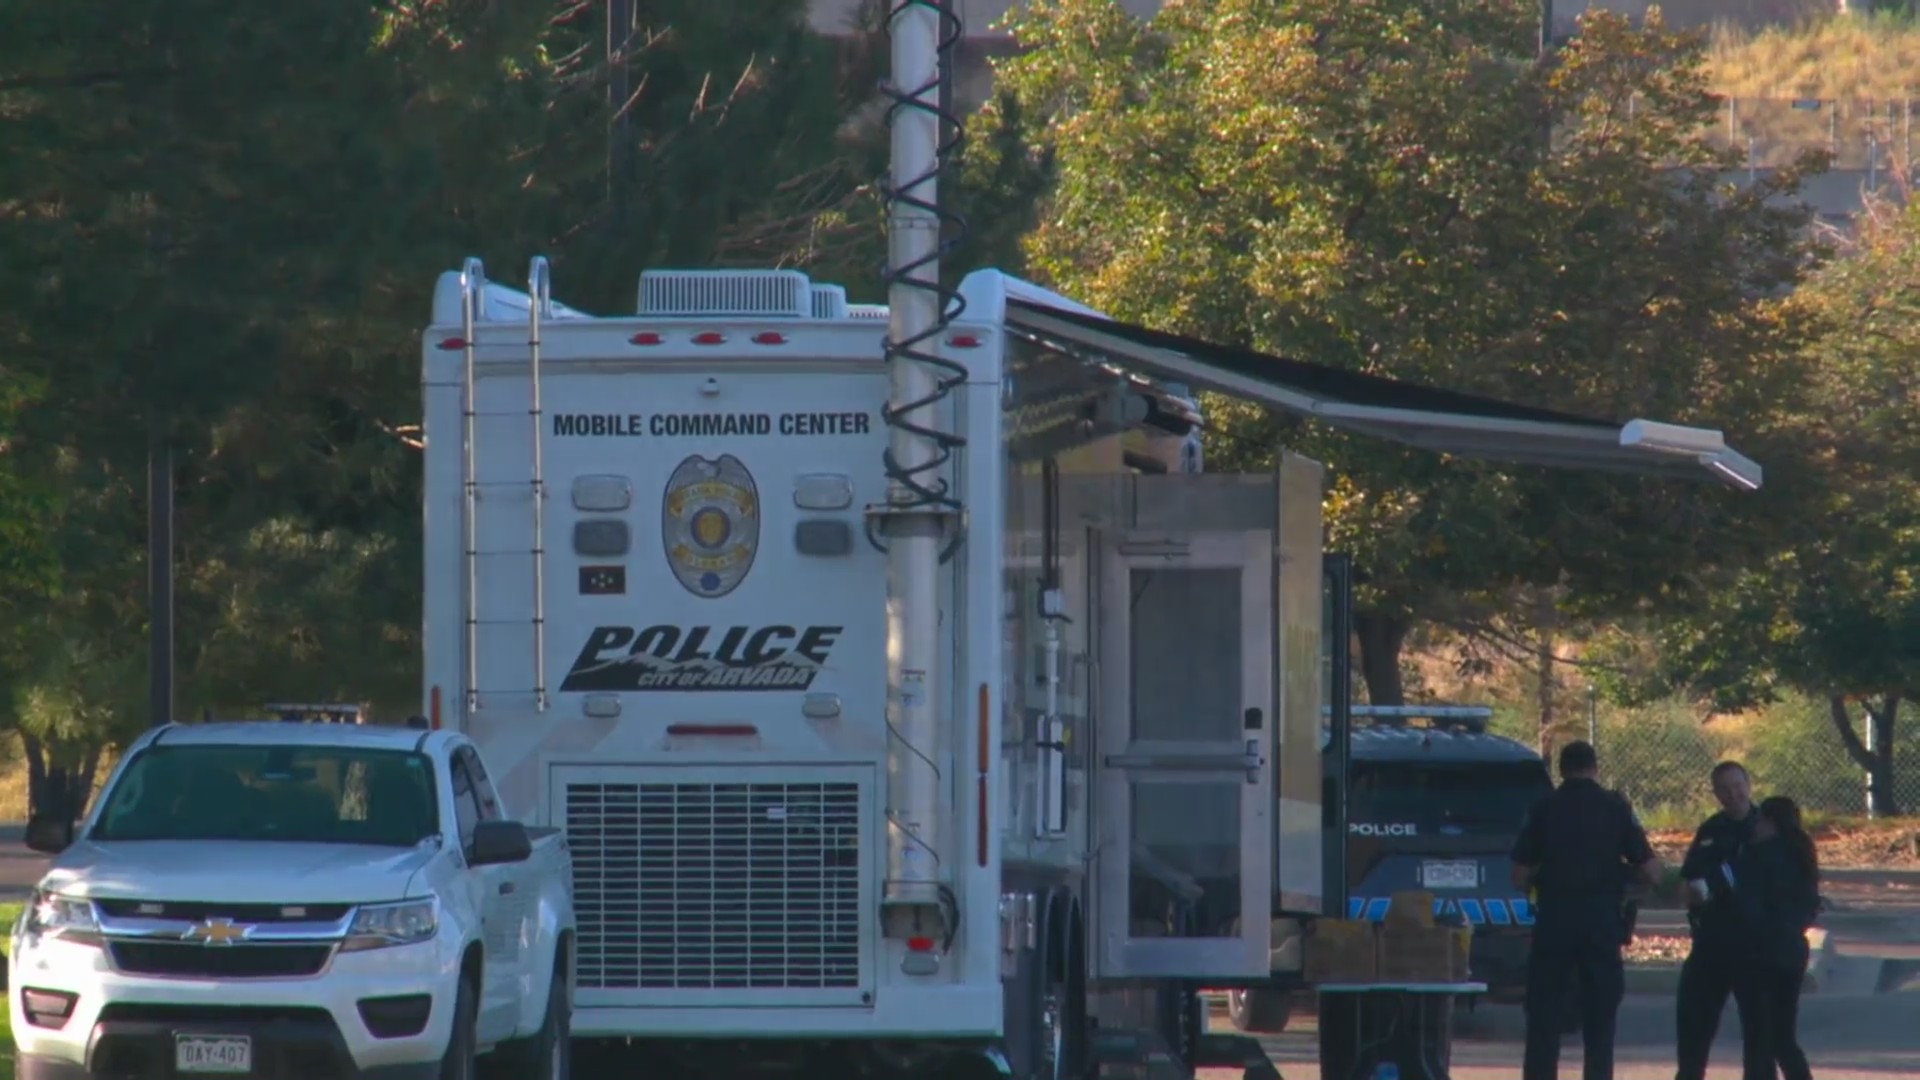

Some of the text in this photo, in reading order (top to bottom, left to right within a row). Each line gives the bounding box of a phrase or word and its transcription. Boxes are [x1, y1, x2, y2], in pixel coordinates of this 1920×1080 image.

[553, 412, 870, 437] MOBILE COMMAND CENTER
[563, 625, 843, 679] POLICE
[638, 666, 810, 687] CITY OF ARVADA
[1348, 822, 1417, 836] POLICE
